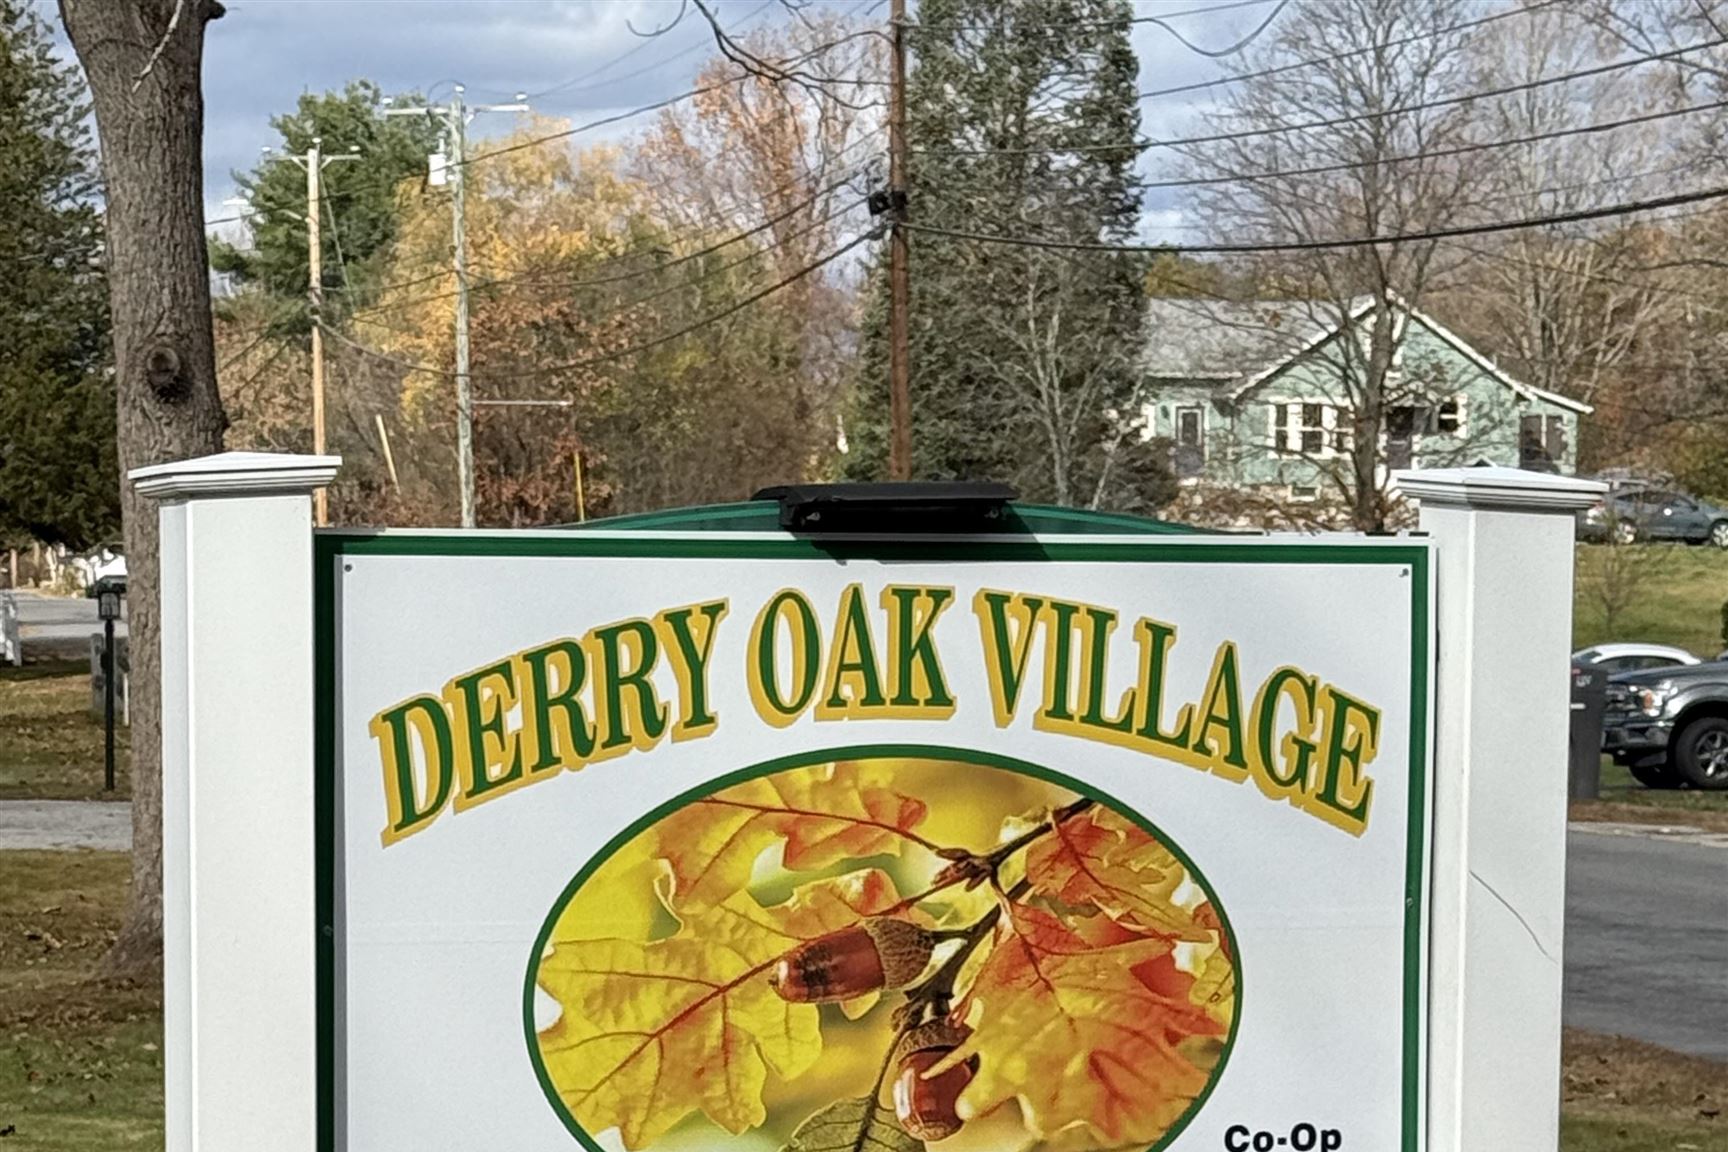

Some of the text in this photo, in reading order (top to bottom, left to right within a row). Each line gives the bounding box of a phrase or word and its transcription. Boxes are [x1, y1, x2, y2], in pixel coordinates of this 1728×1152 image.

[368, 583, 1382, 849] DERRY OAK VILLAGE
